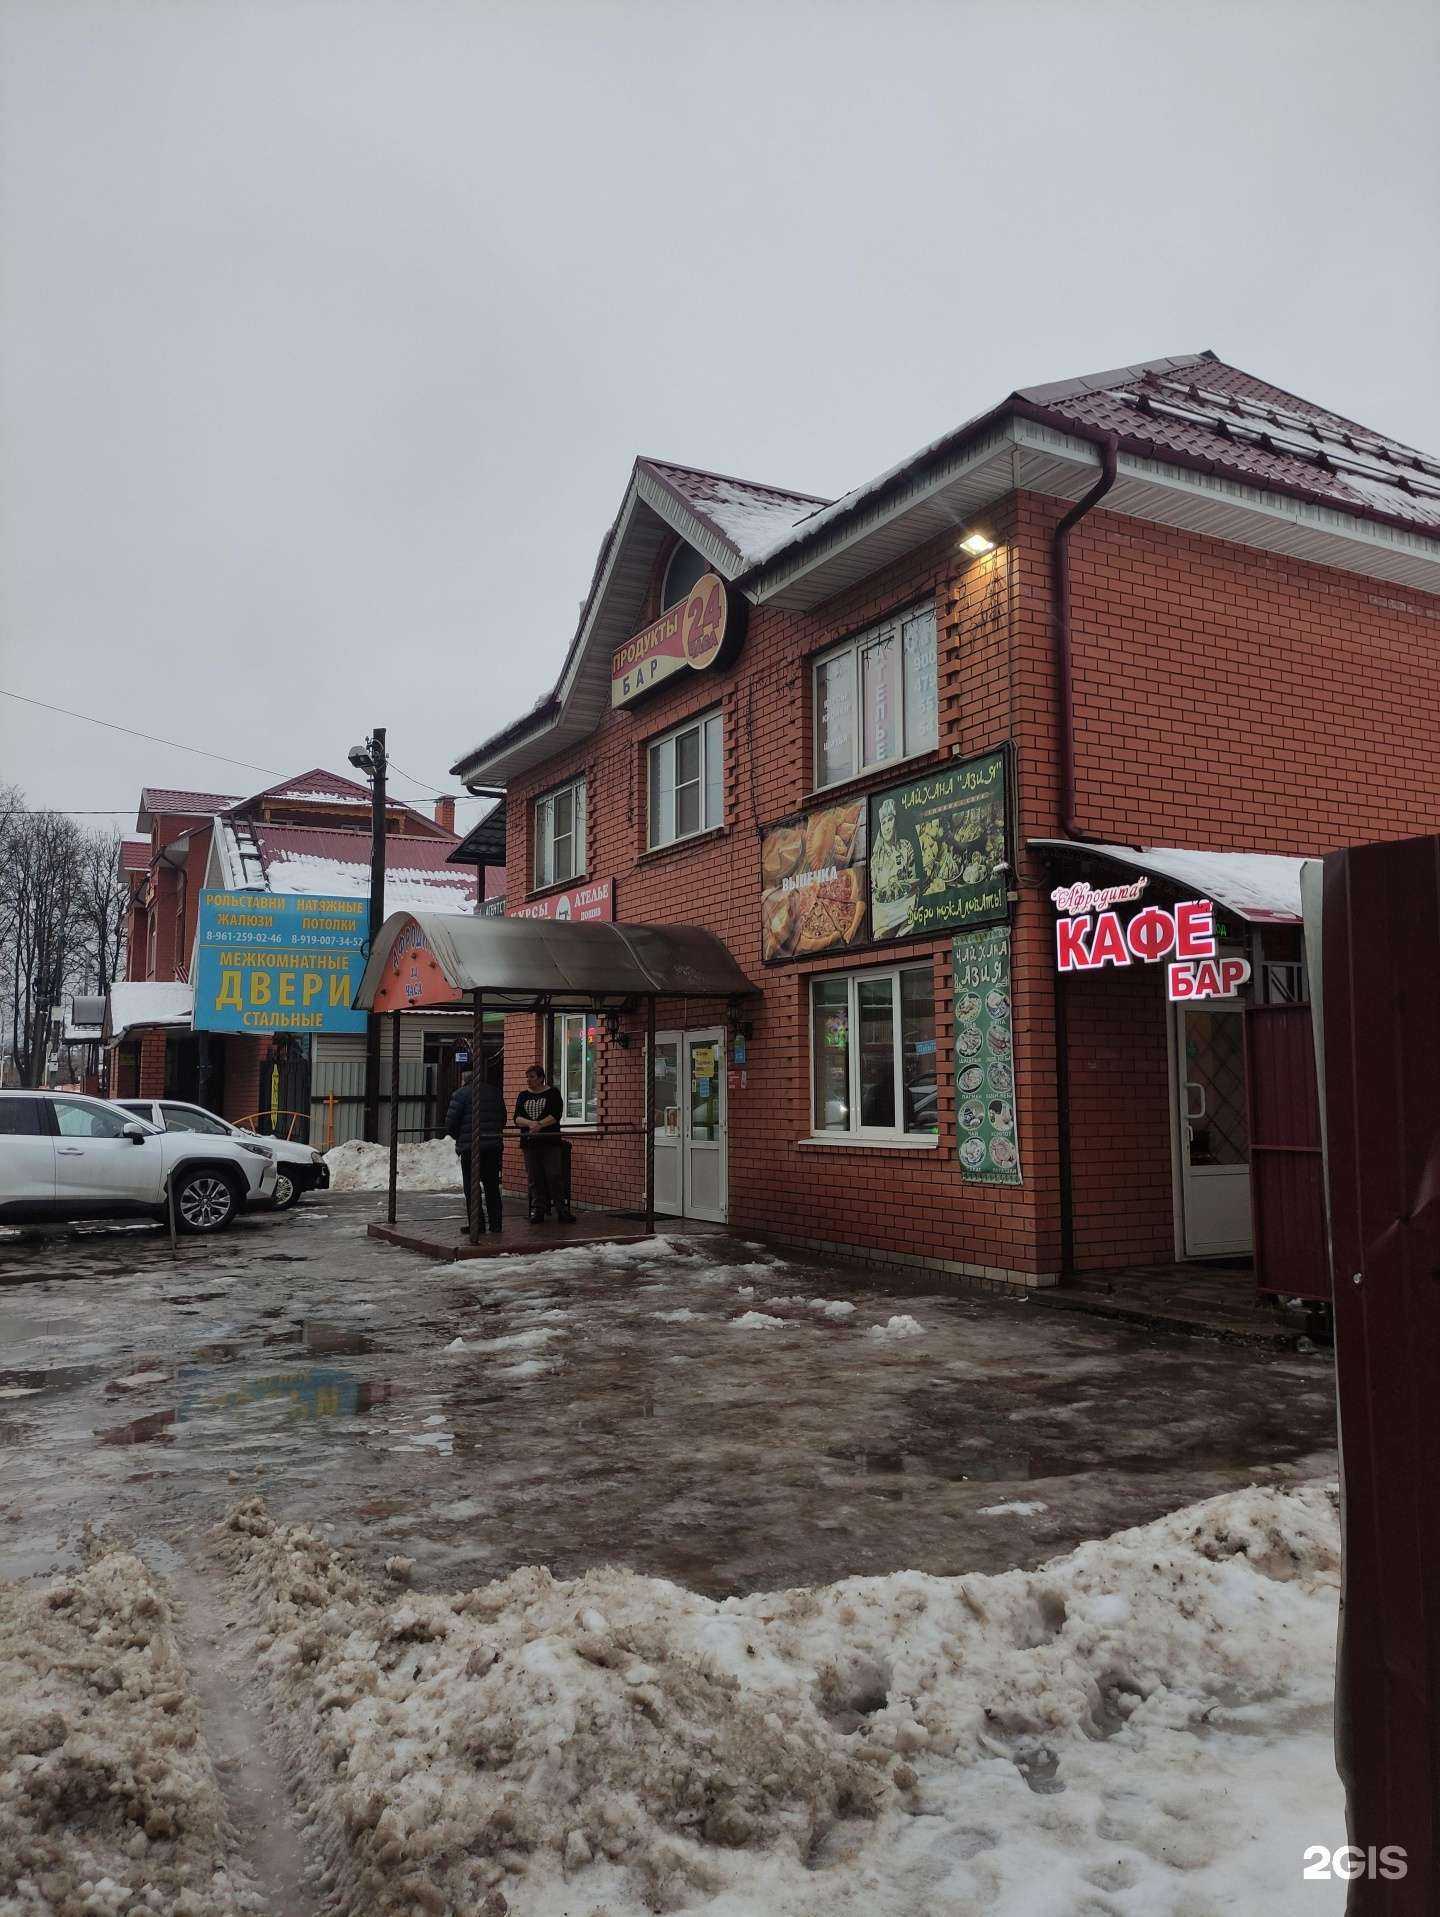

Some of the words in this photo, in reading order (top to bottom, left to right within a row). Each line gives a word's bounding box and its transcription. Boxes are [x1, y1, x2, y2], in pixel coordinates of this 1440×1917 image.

[688, 583, 721, 641] 24
[612, 613, 678, 673] ПРОДУКТЫ
[622, 658, 659, 696] БАР
[901, 778, 954, 811] ЧАЙХАНА
[957, 760, 1002, 791] "АЗИЯ"
[206, 894, 286, 912] РОЛЬСТАВНИ
[297, 898, 363, 914] НАТЯЖНЫЕ
[574, 884, 609, 908] АТЕЛЬЕ
[217, 913, 273, 928] ЖАЛЮЗИ
[302, 917, 357, 932] ПОТОЛКИ
[206, 930, 282, 943] 8-961-259-02-46
[291, 934, 364, 946] 8-919-007-34-52
[1056, 899, 1216, 972] КАФЕ
[220, 952, 349, 970] МЕЖКОМНАТНЫЕ
[961, 961, 1003, 987] АЗИЯ
[1168, 957, 1251, 1001] БАР
[215, 970, 352, 1011] ДВЕРИ
[243, 1011, 323, 1027] СТАЛЬНЫЕ
